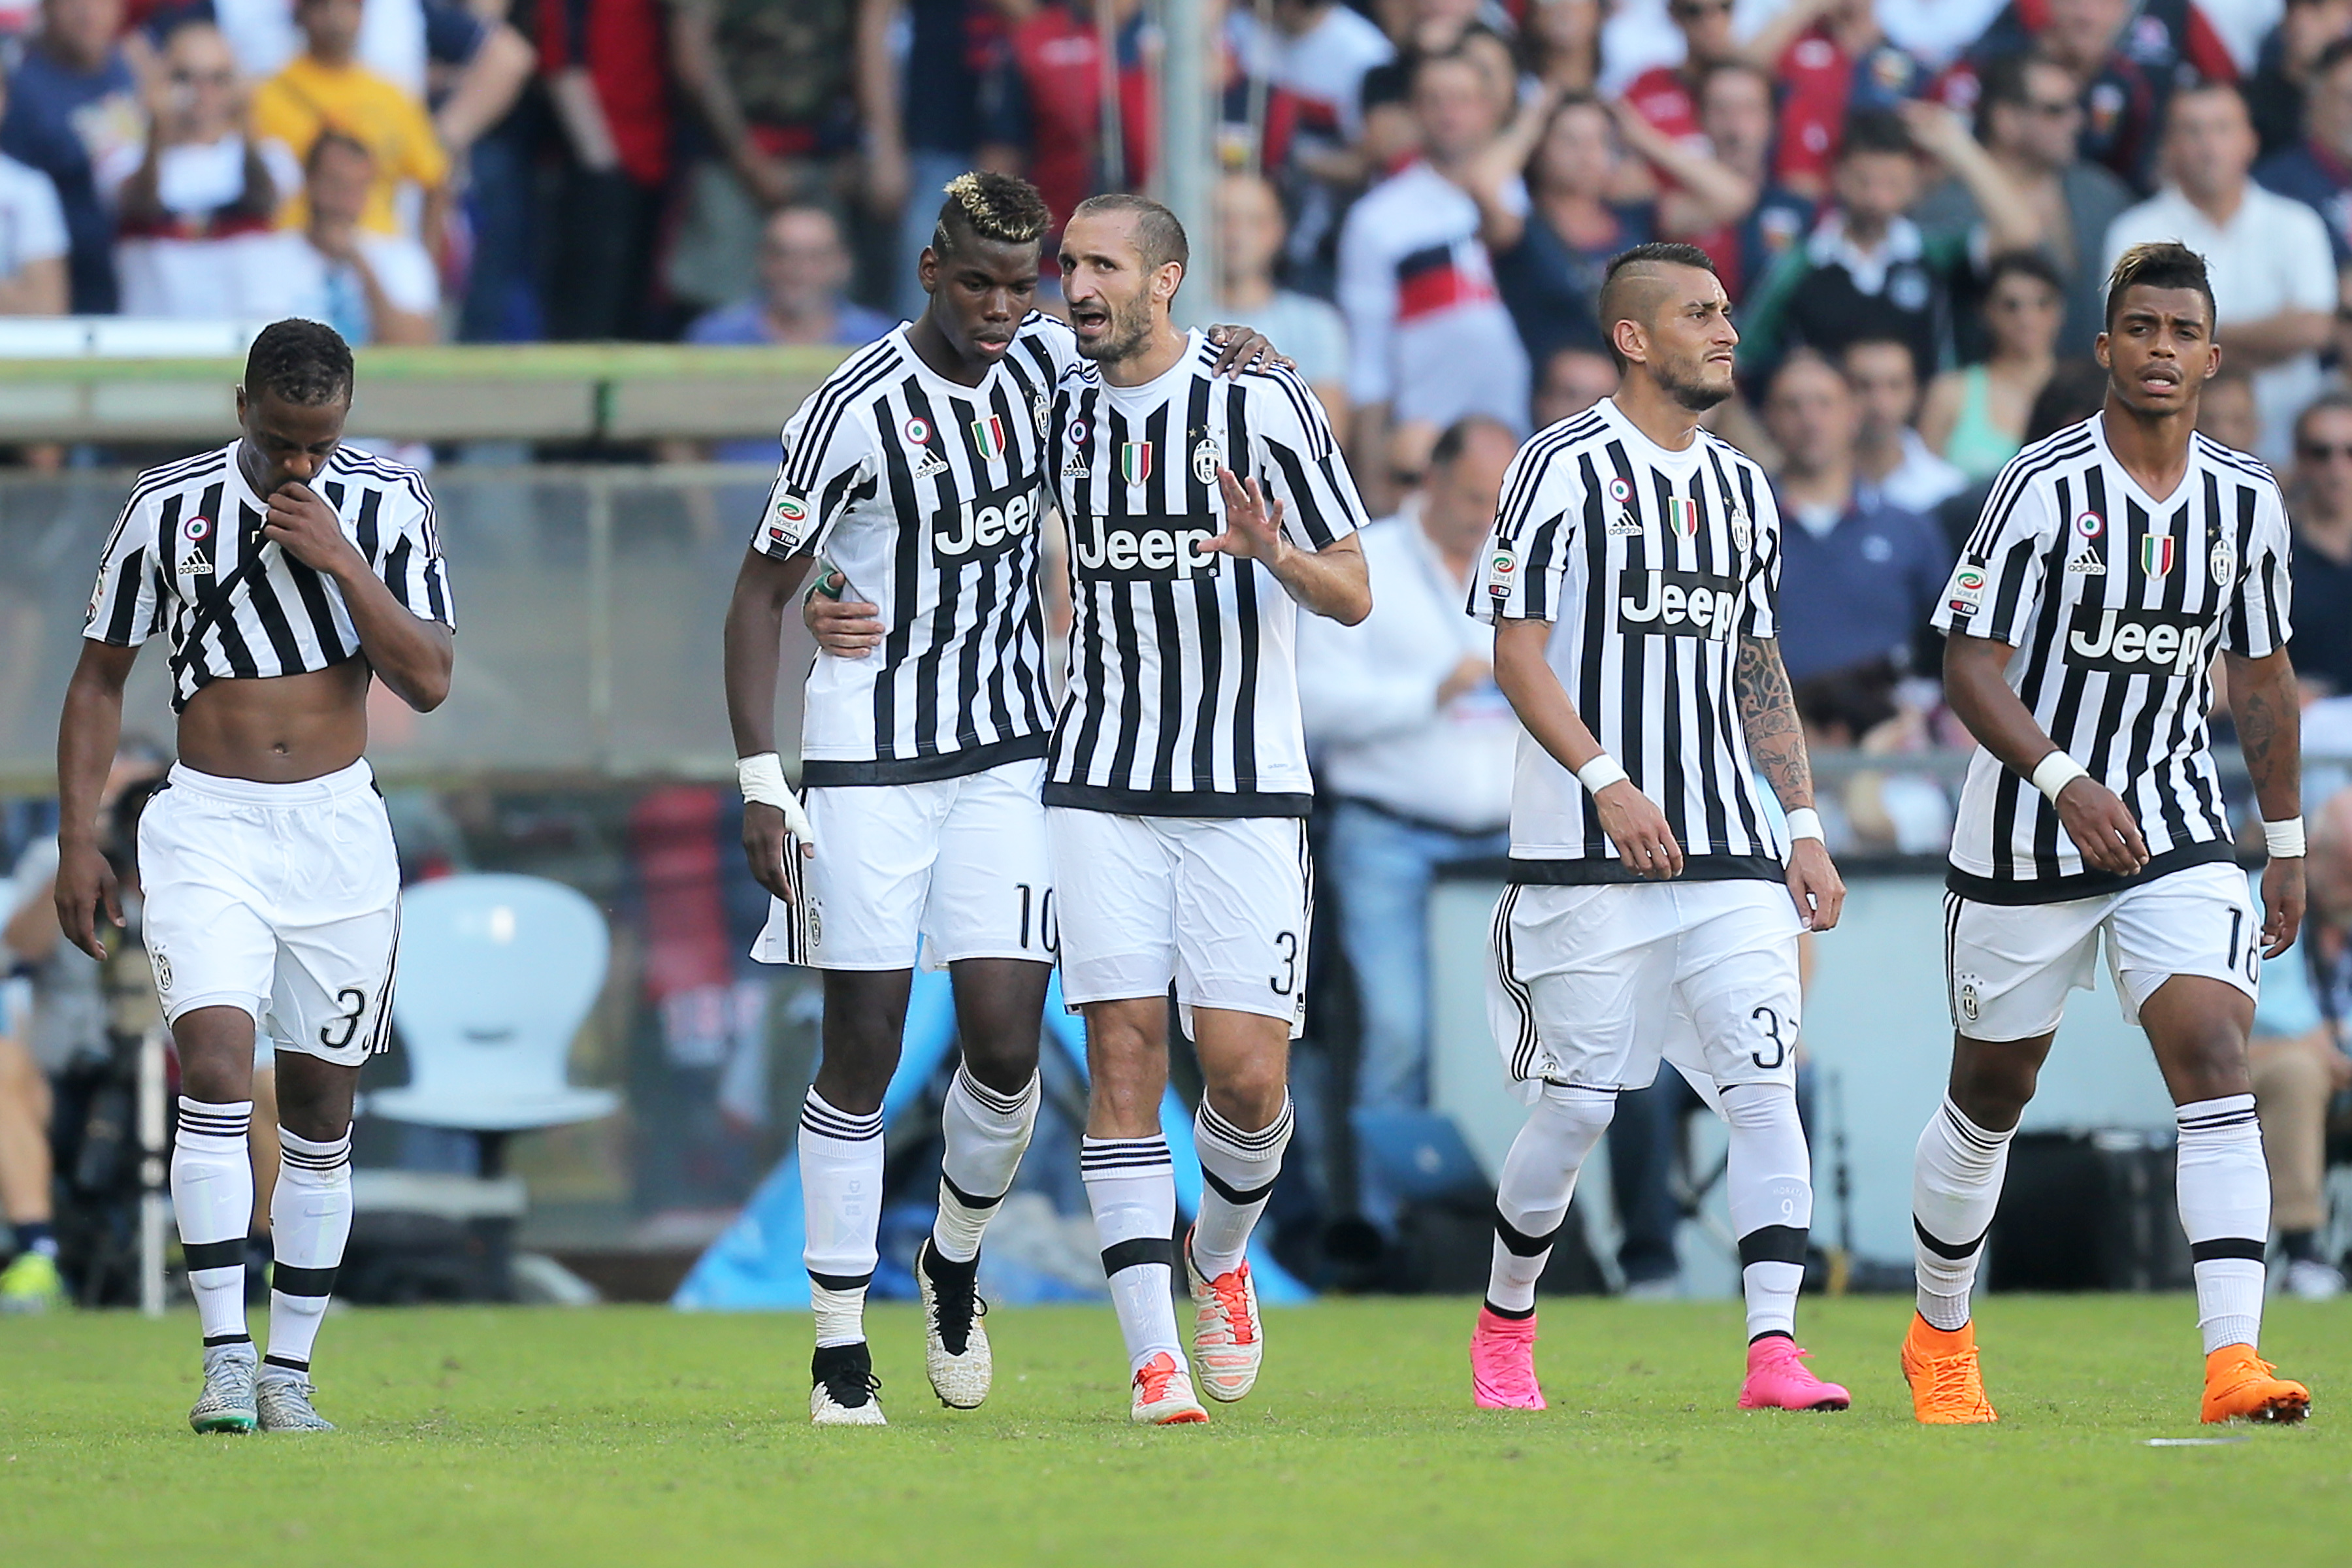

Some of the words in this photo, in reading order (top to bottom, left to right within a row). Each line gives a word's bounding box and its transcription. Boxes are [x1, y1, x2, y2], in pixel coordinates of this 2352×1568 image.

[781, 532, 797, 545] TIM
[935, 481, 1041, 555] Jeep
[1078, 517, 1215, 580] Jeep
[1621, 570, 1734, 640] Jeep
[2070, 610, 2202, 676] Jeep
[1017, 885, 1058, 953] 10
[2229, 907, 2259, 985] 18
[1270, 931, 1297, 996] 3
[321, 988, 372, 1051] 3
[1781, 1198, 1793, 1222] 9
